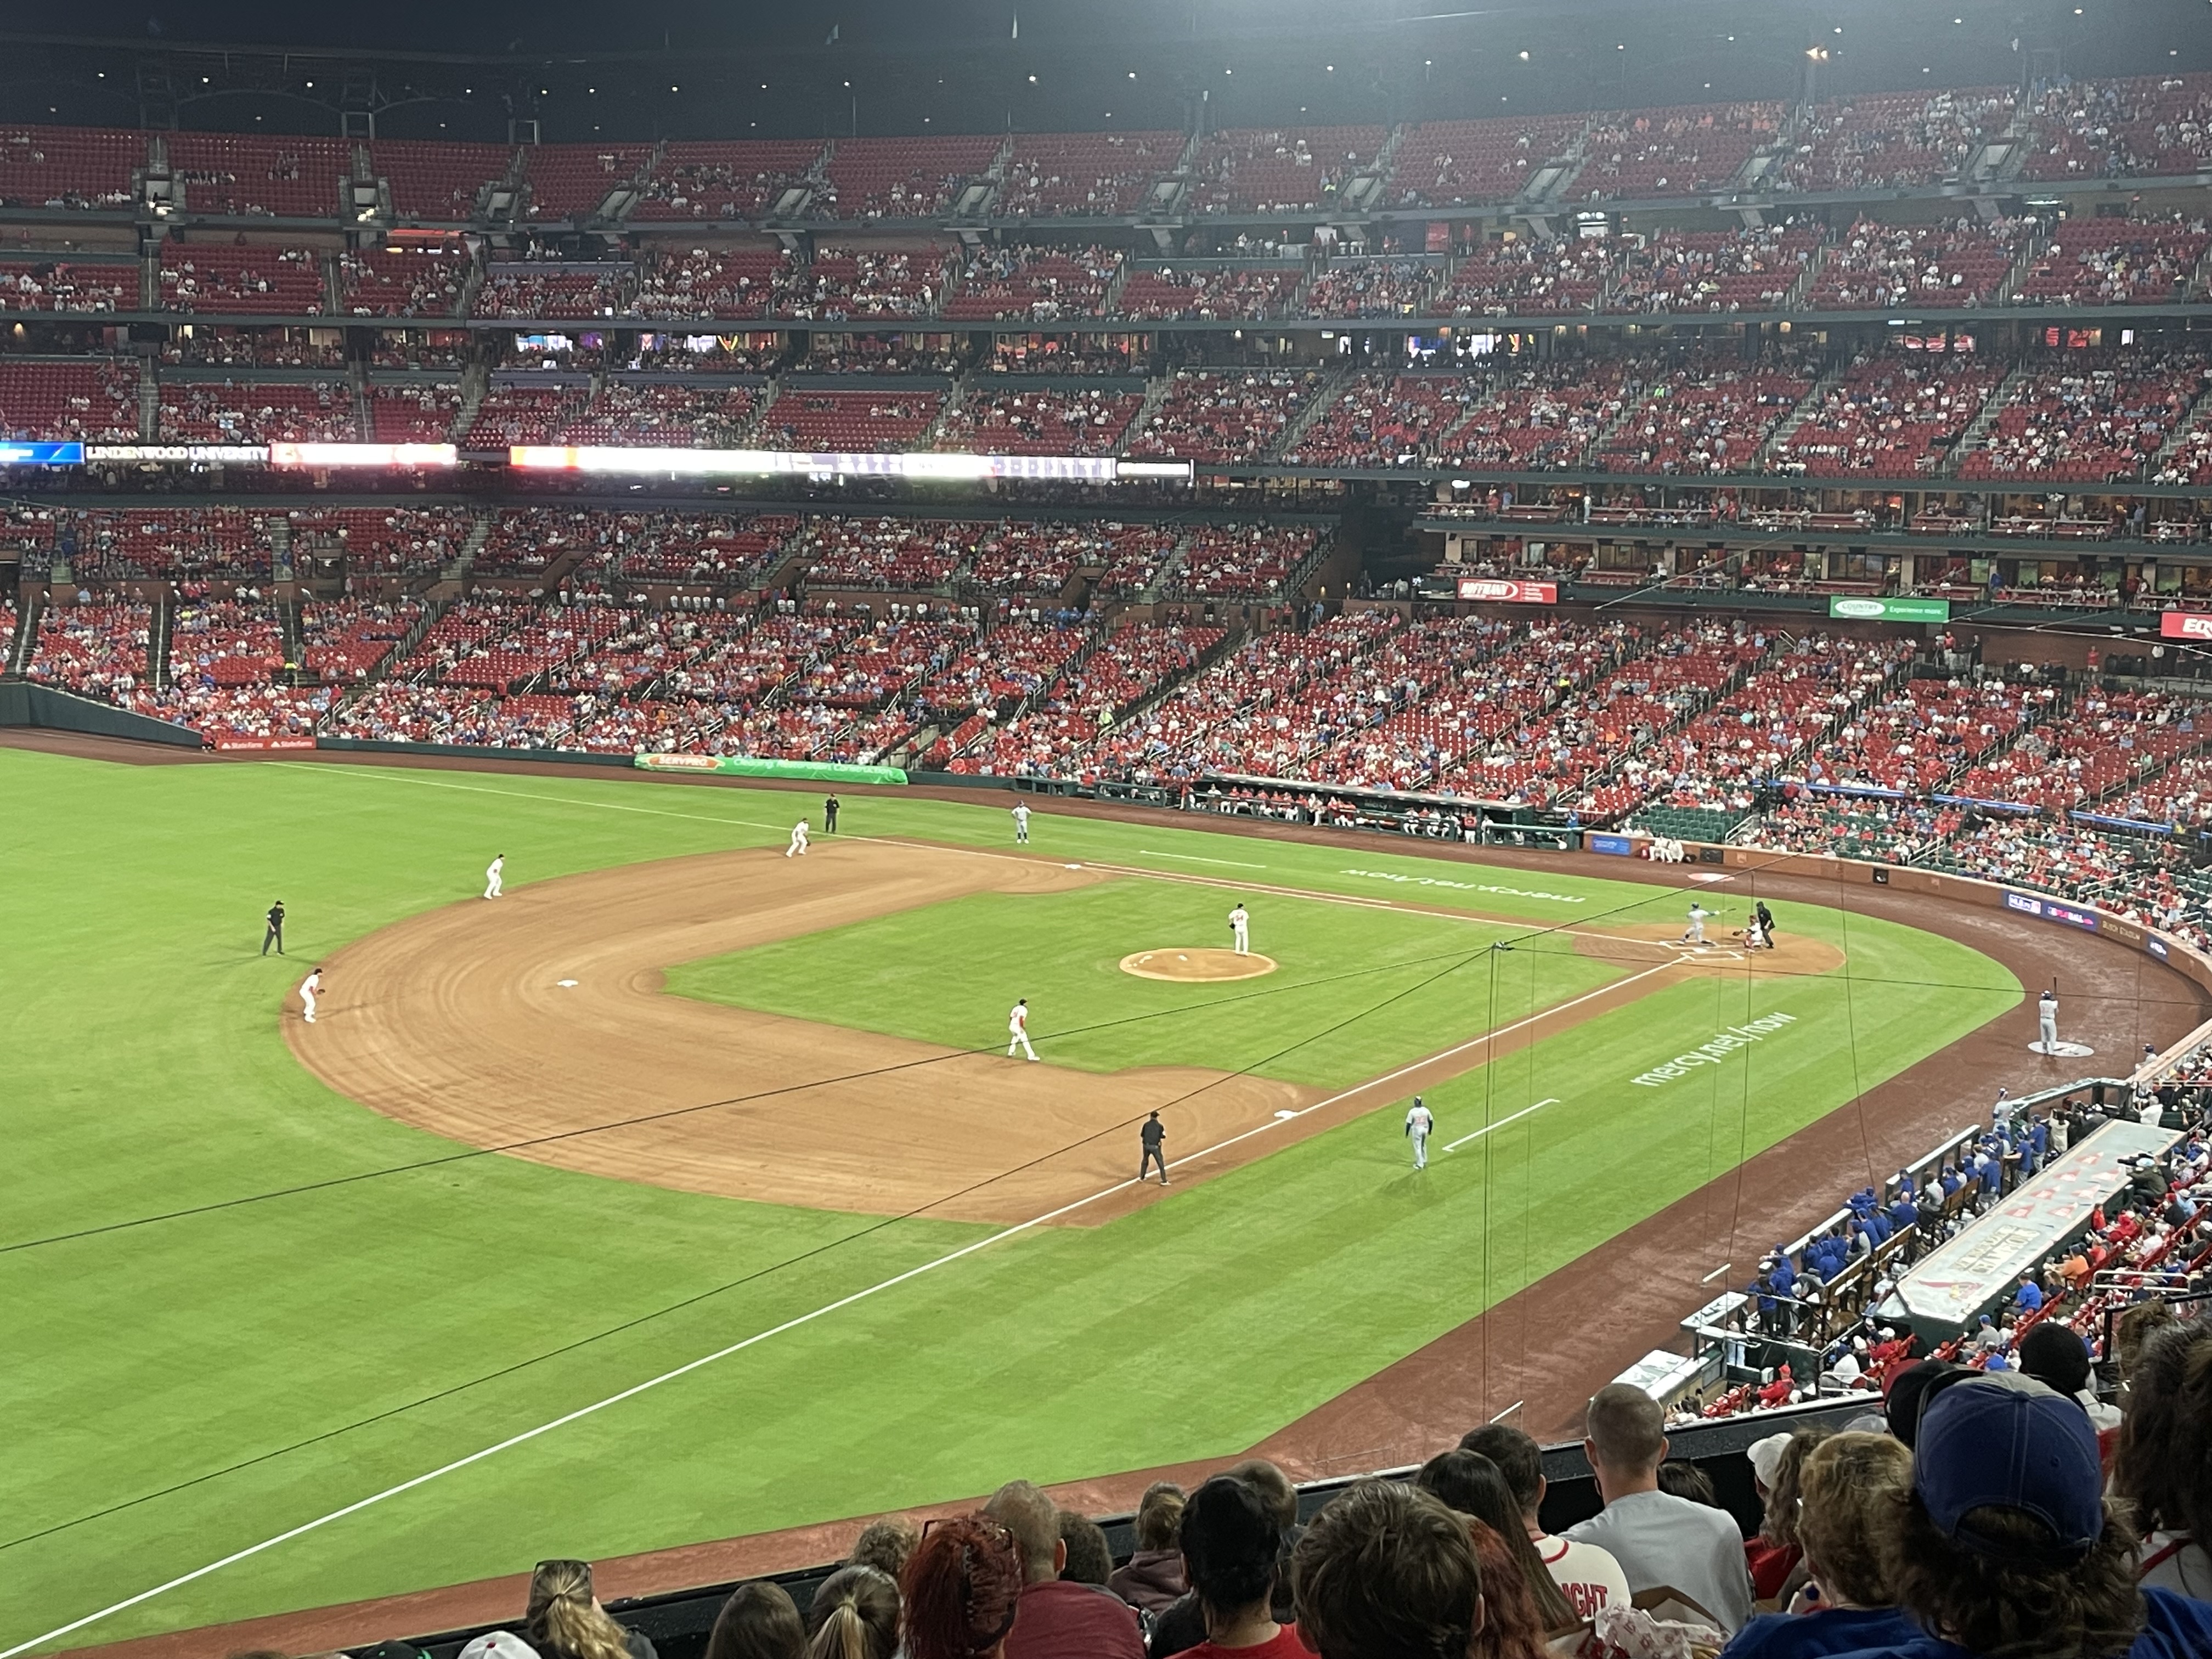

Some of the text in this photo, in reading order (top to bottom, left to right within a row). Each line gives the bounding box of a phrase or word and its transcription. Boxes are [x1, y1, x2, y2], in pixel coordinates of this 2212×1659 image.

[86, 446, 188, 459] LINDENWOOD
[189, 447, 269, 460] UNIVERSITY
[1842, 602, 1878, 611] COUNTRY
[1889, 606, 1923, 614] Experience
[2182, 618, 2212, 638] EQ
[1629, 1011, 1798, 1087] mercy.net/now
[1561, 1582, 1608, 1617] IGHT
